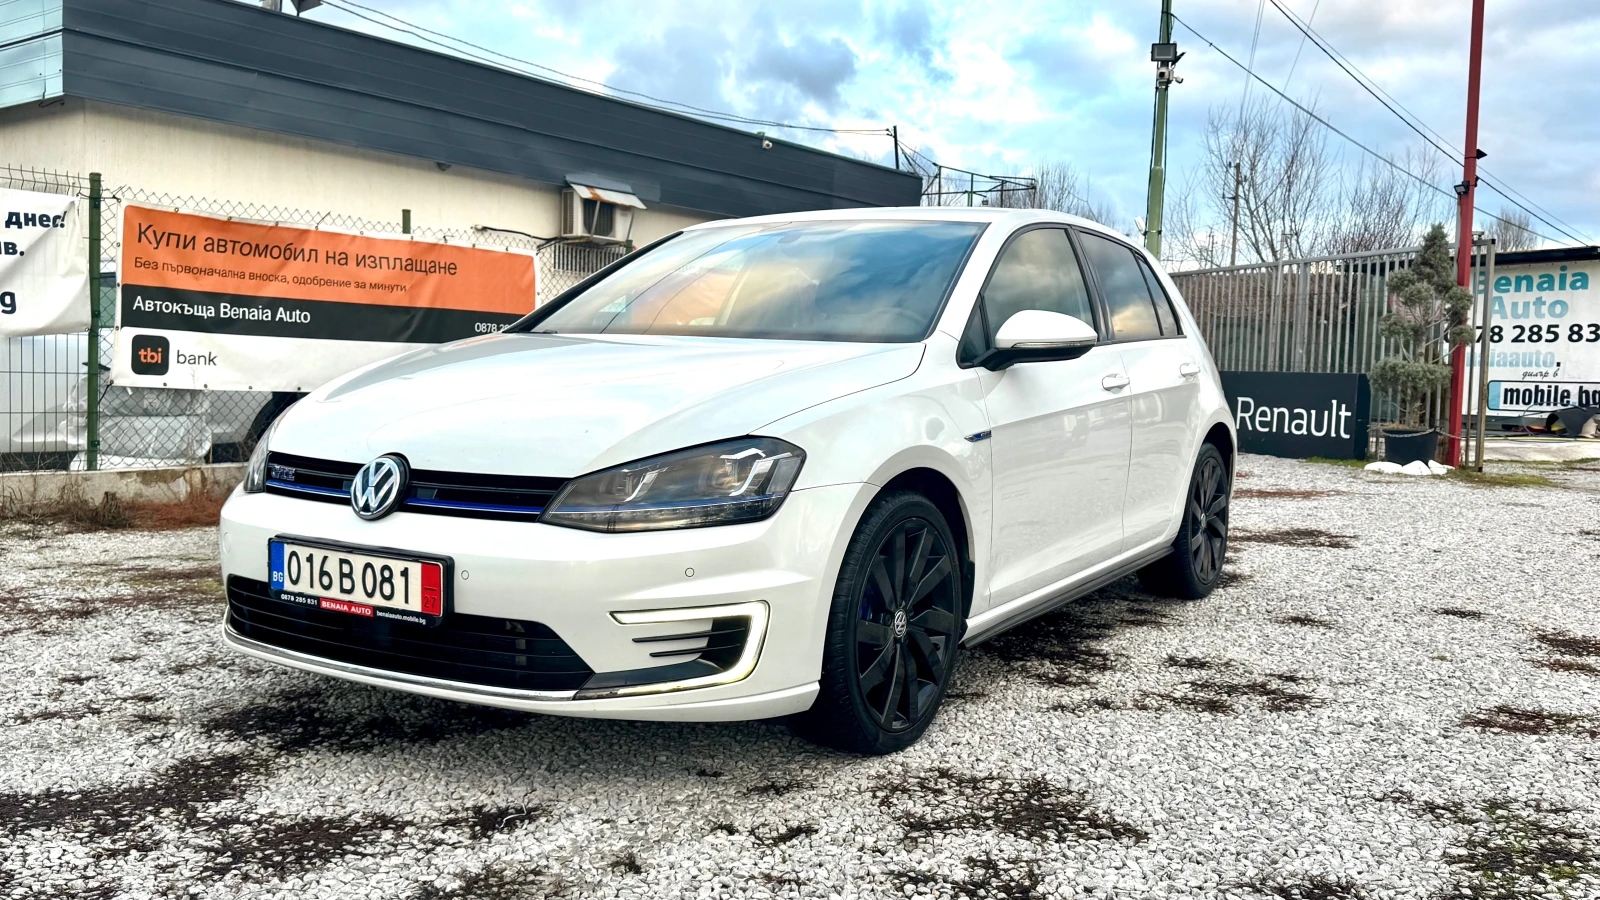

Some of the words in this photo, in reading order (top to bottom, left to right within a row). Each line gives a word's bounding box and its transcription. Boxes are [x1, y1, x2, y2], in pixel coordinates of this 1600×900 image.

[0, 241, 25, 256] в.
[137, 222, 196, 250] Купи
[203, 236, 318, 264] автомобил
[325, 251, 348, 267] на
[355, 254, 457, 276] изплащане
[134, 257, 158, 270] Без
[162, 263, 246, 280] първоначална
[248, 272, 290, 285] вноска,
[292, 275, 351, 288] одобрение
[353, 281, 367, 290] за
[369, 282, 407, 293] минути
[133, 296, 215, 319] Автокъща
[220, 303, 272, 321] Benaia
[275, 307, 311, 323] Auto
[1491, 295, 1569, 319] Auto
[474, 322, 498, 333] 0878
[1511, 324, 1560, 343] 285
[138, 347, 162, 363] tbi
[176, 350, 218, 367] bank
[1236, 397, 1351, 439] Renault
[273, 570, 284, 582] BG
[287, 550, 410, 605] 016B081
[321, 601, 348, 611] BENAIA
[350, 606, 371, 615] AUTO
[424, 596, 437, 609] 27
